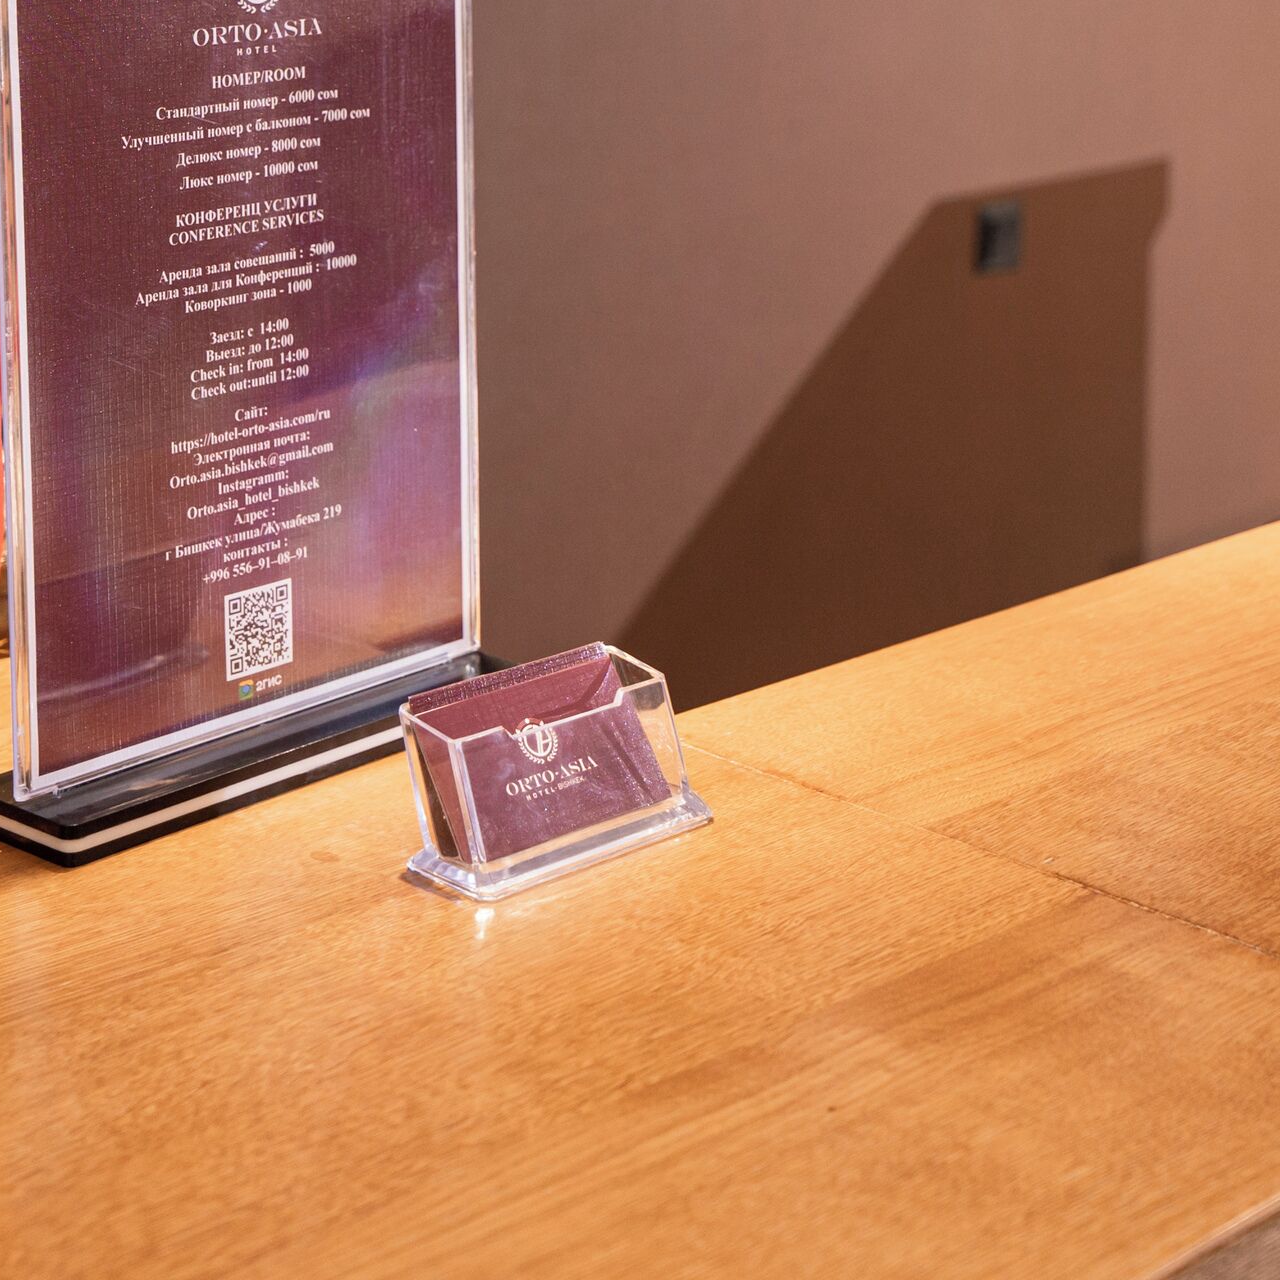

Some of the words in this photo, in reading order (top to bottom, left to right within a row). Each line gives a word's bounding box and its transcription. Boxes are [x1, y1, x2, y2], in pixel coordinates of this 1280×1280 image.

[237, 45, 276, 56] HOTEL
[213, 66, 305, 89] НОМЕР/ROOM
[156, 99, 239, 120] Стандартный
[244, 96, 278, 110] номер
[289, 89, 314, 103] 6000
[318, 89, 338, 100] сом
[122, 126, 203, 151] Улучшенный
[208, 124, 243, 138] номер
[247, 123, 252, 132] с
[256, 116, 310, 131] балконом
[322, 108, 347, 122] 7000
[350, 108, 370, 119] сом
[176, 150, 222, 168] Делюкс
[227, 145, 261, 159] номер
[272, 137, 297, 152] 8000
[300, 137, 320, 149] сом
[180, 176, 213, 190] Люкс
[217, 170, 252, 185] номер
[265, 161, 294, 177] 10000
[298, 161, 318, 172] сом
[176, 202, 261, 228] КОНФЕРЕНЦ
[265, 193, 316, 213] УСЛУГИ
[169, 219, 258, 246] CONFERENCE
[263, 209, 324, 230] SERVICES
[160, 267, 202, 285] Аренда
[207, 262, 230, 274] зала
[310, 241, 334, 256] 5000
[136, 288, 179, 307] Аренда
[185, 283, 208, 296] зала
[212, 279, 231, 291] для
[236, 262, 312, 287] Конференций
[327, 254, 356, 270] 10000
[186, 294, 246, 314] Коворкинг
[253, 288, 276, 300] зона
[288, 278, 311, 294] 1000
[210, 329, 243, 344] Заезд:
[248, 328, 253, 337] с
[261, 318, 289, 335] 14:00
[206, 346, 245, 363] Выезд:
[248, 344, 262, 355] до
[266, 333, 293, 350] 12:00
[191, 365, 225, 383] Check
[230, 363, 243, 375] in:
[248, 358, 273, 371] from
[281, 347, 308, 364] 14:00
[191, 382, 226, 400] Check
[281, 364, 309, 381] 12:00
[235, 406, 267, 422] Сайт:
[172, 409, 330, 455] https://hotel-orto-asia.com/ru
[194, 440, 271, 466] Электронная
[274, 431, 309, 447] почта:
[170, 442, 333, 489] Orto.asia.bishkek@gmail.com
[219, 469, 288, 495] Instagramm:
[187, 477, 319, 519] Orto.asia_hotel_bishkek
[166, 550, 172, 562] г
[176, 537, 223, 559] Бишкек
[324, 504, 341, 520] 219
[235, 507, 268, 526] Адрес
[224, 540, 281, 563] контакты
[203, 565, 231, 583] +996
[255, 674, 283, 692] 2ГИС
